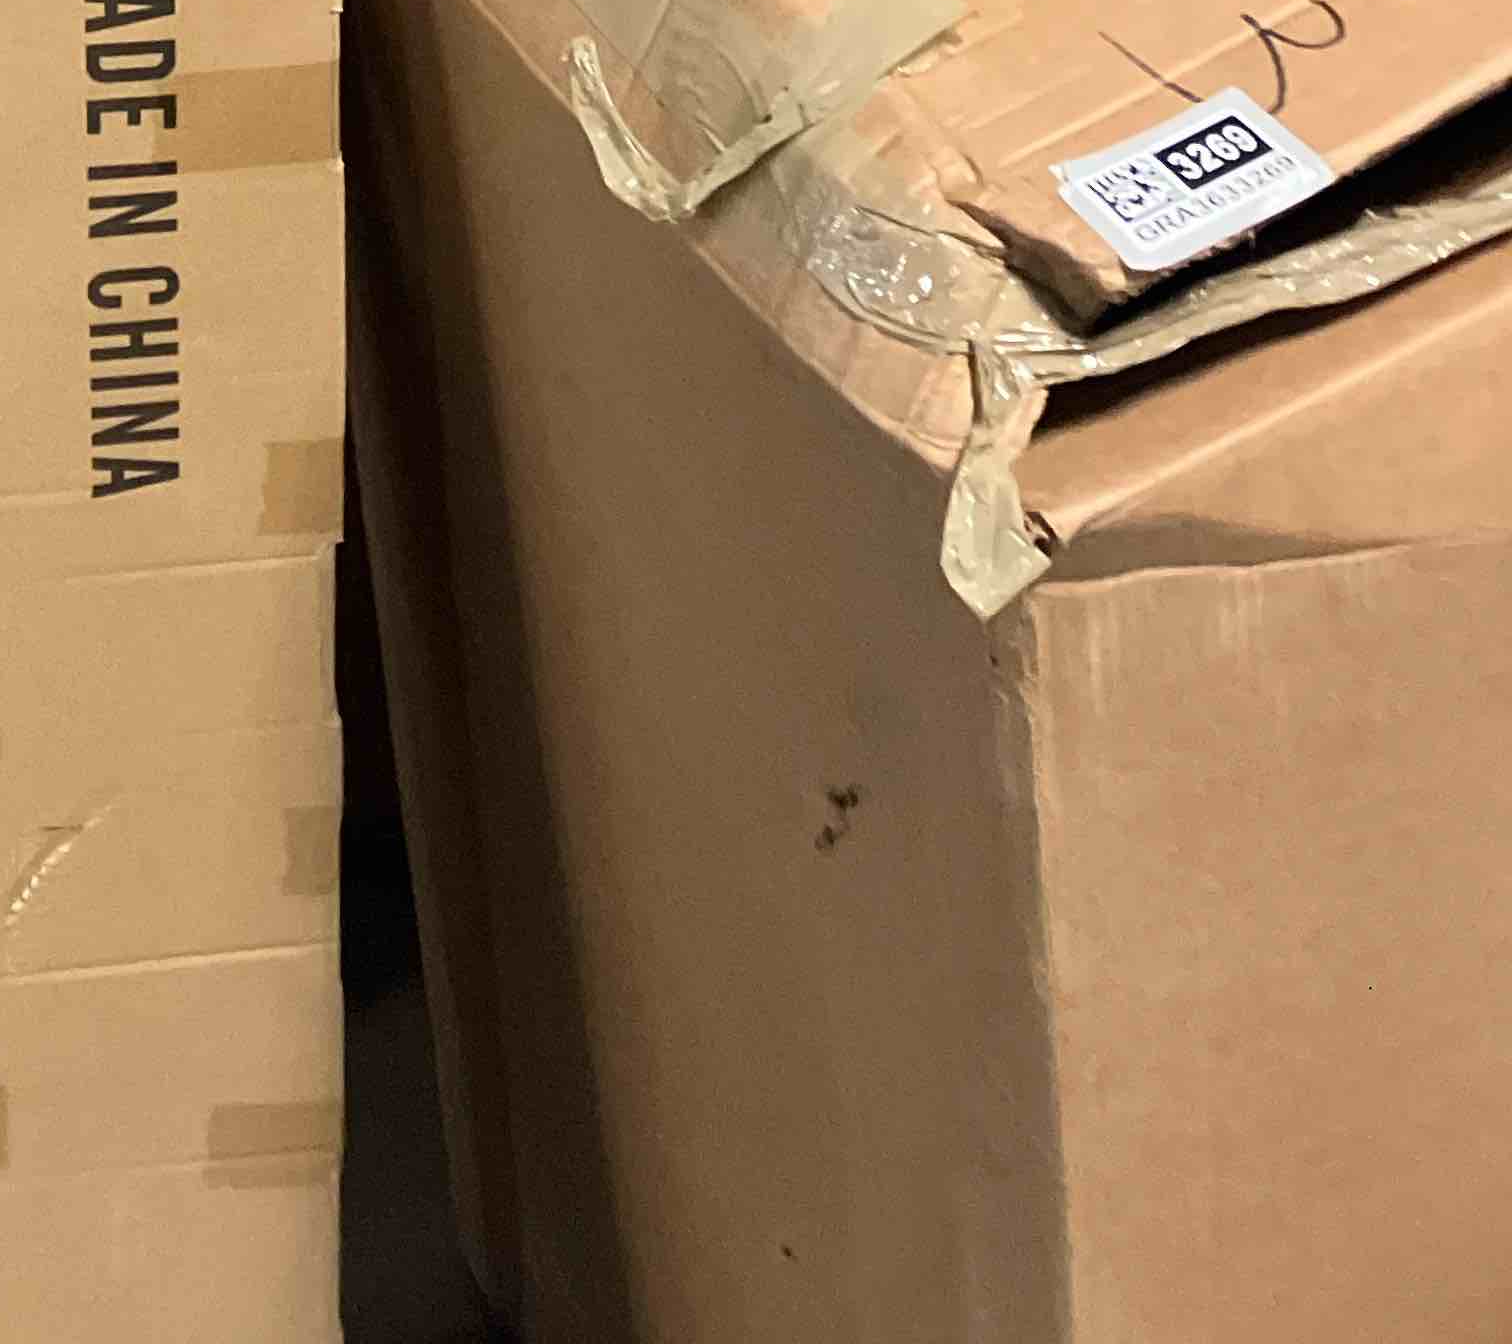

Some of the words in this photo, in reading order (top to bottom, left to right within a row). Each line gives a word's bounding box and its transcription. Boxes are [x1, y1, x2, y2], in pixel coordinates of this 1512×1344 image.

[1166, 114, 1259, 180] 3269
[87, 160, 179, 240] IN
[87, 265, 181, 499] CHINA
